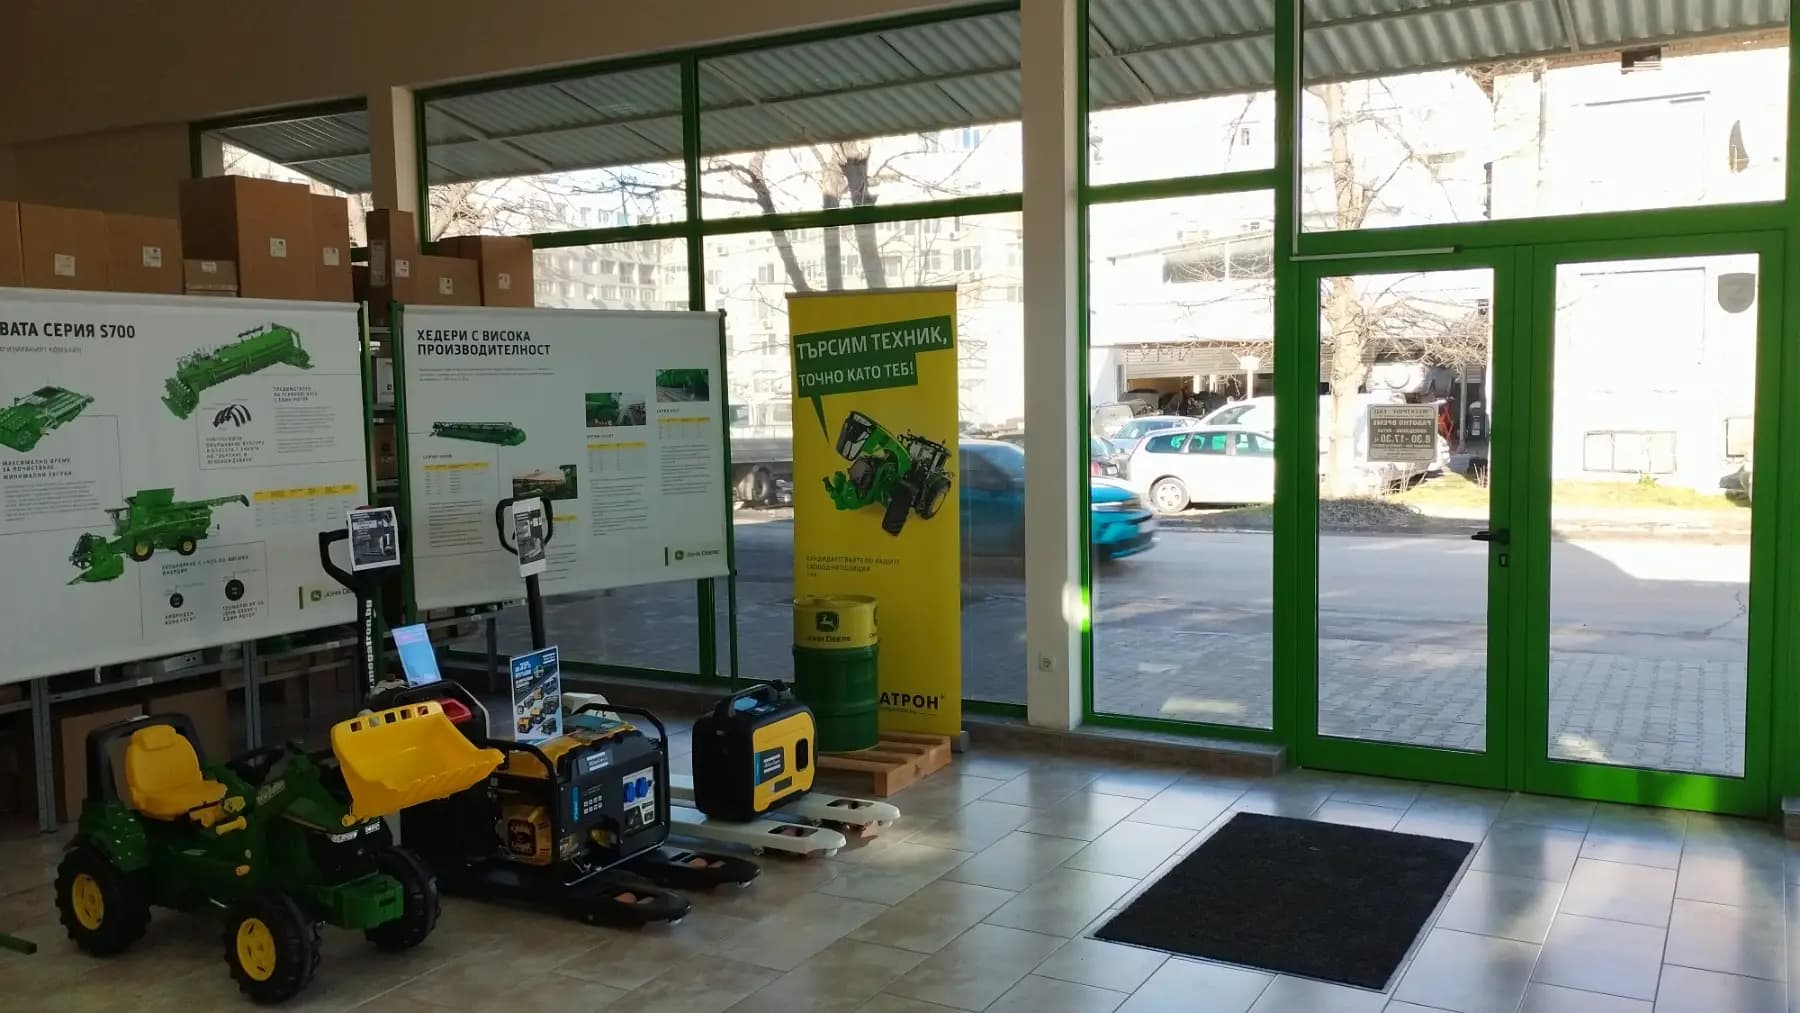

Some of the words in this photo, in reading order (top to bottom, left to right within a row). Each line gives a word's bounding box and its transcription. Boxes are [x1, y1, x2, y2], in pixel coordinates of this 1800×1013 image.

[0, 321, 39, 337] ВАТА
[43, 322, 95, 338] СЕРИЯ
[100, 324, 136, 338] S700
[417, 330, 468, 343] ХЕДЕРИ
[471, 331, 480, 342] С
[483, 331, 531, 342] ВИСОКА
[417, 344, 551, 356] ПРОИЗВОДИТЕЛНОСТ
[796, 335, 867, 361] ТЪРСИМ
[871, 325, 948, 351] ТЕХНИК,
[799, 369, 844, 387] ТОЧНО
[848, 365, 881, 382] КАТО
[883, 361, 914, 377] ТЕБ!
[879, 691, 939, 710] АТРОН
